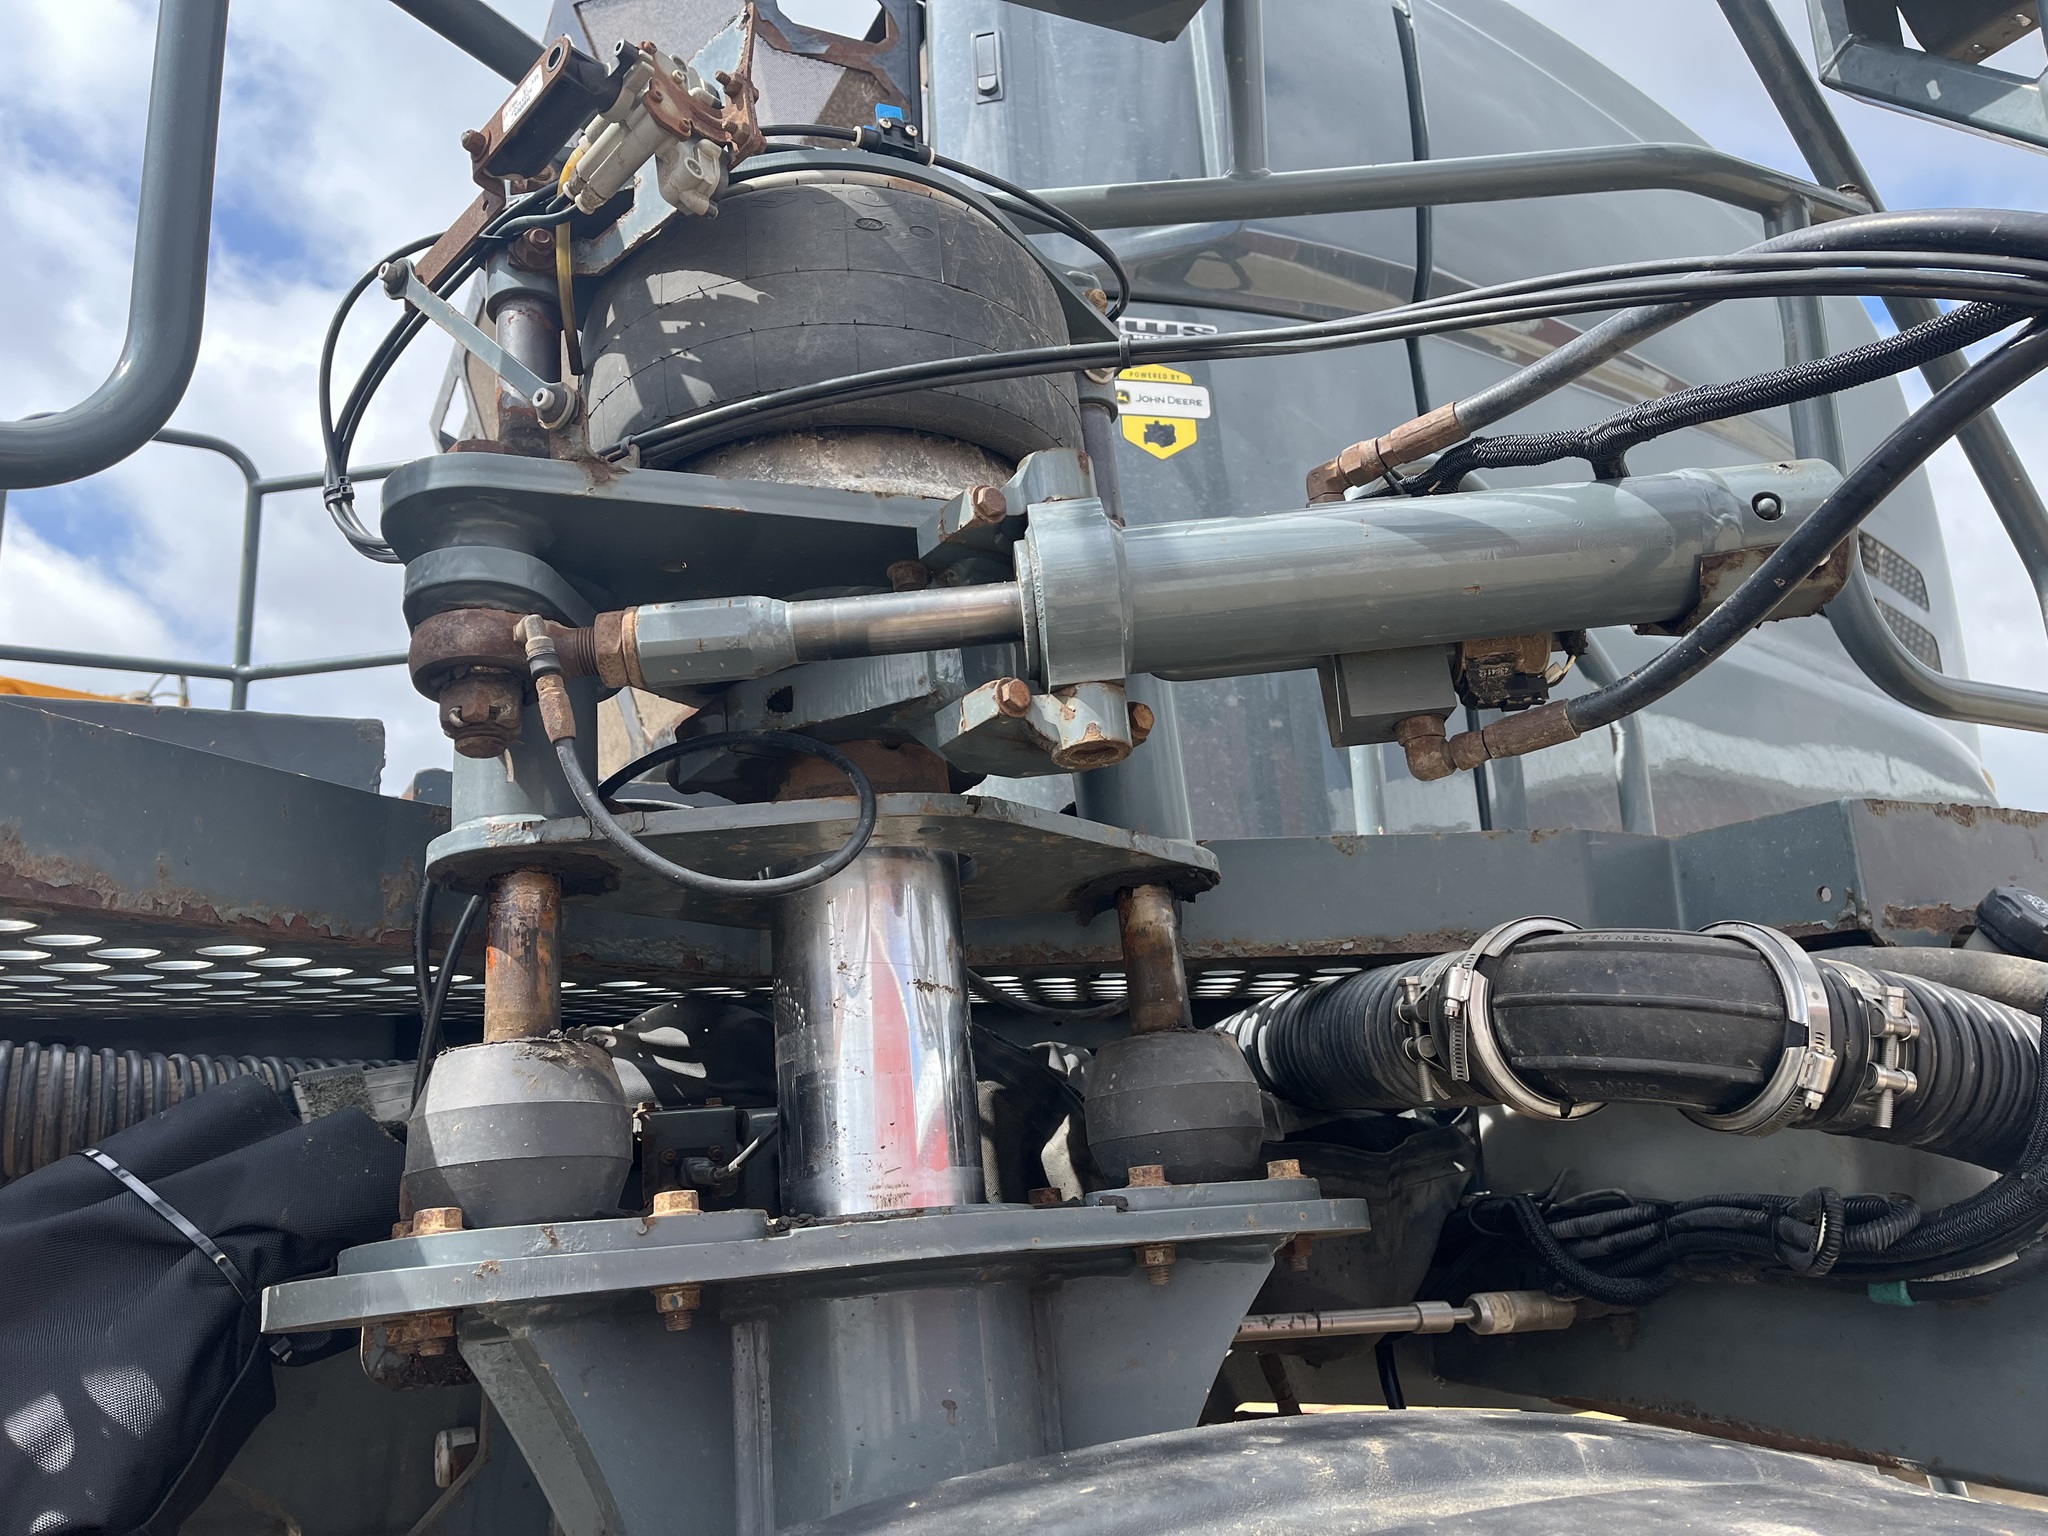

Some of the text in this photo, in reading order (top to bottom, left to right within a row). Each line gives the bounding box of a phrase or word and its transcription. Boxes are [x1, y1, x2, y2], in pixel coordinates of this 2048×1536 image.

[1129, 371, 1168, 380] POWERED
[1135, 394, 1203, 407] JOHN DEERE
[1588, 1080, 1660, 1095] BANJO
